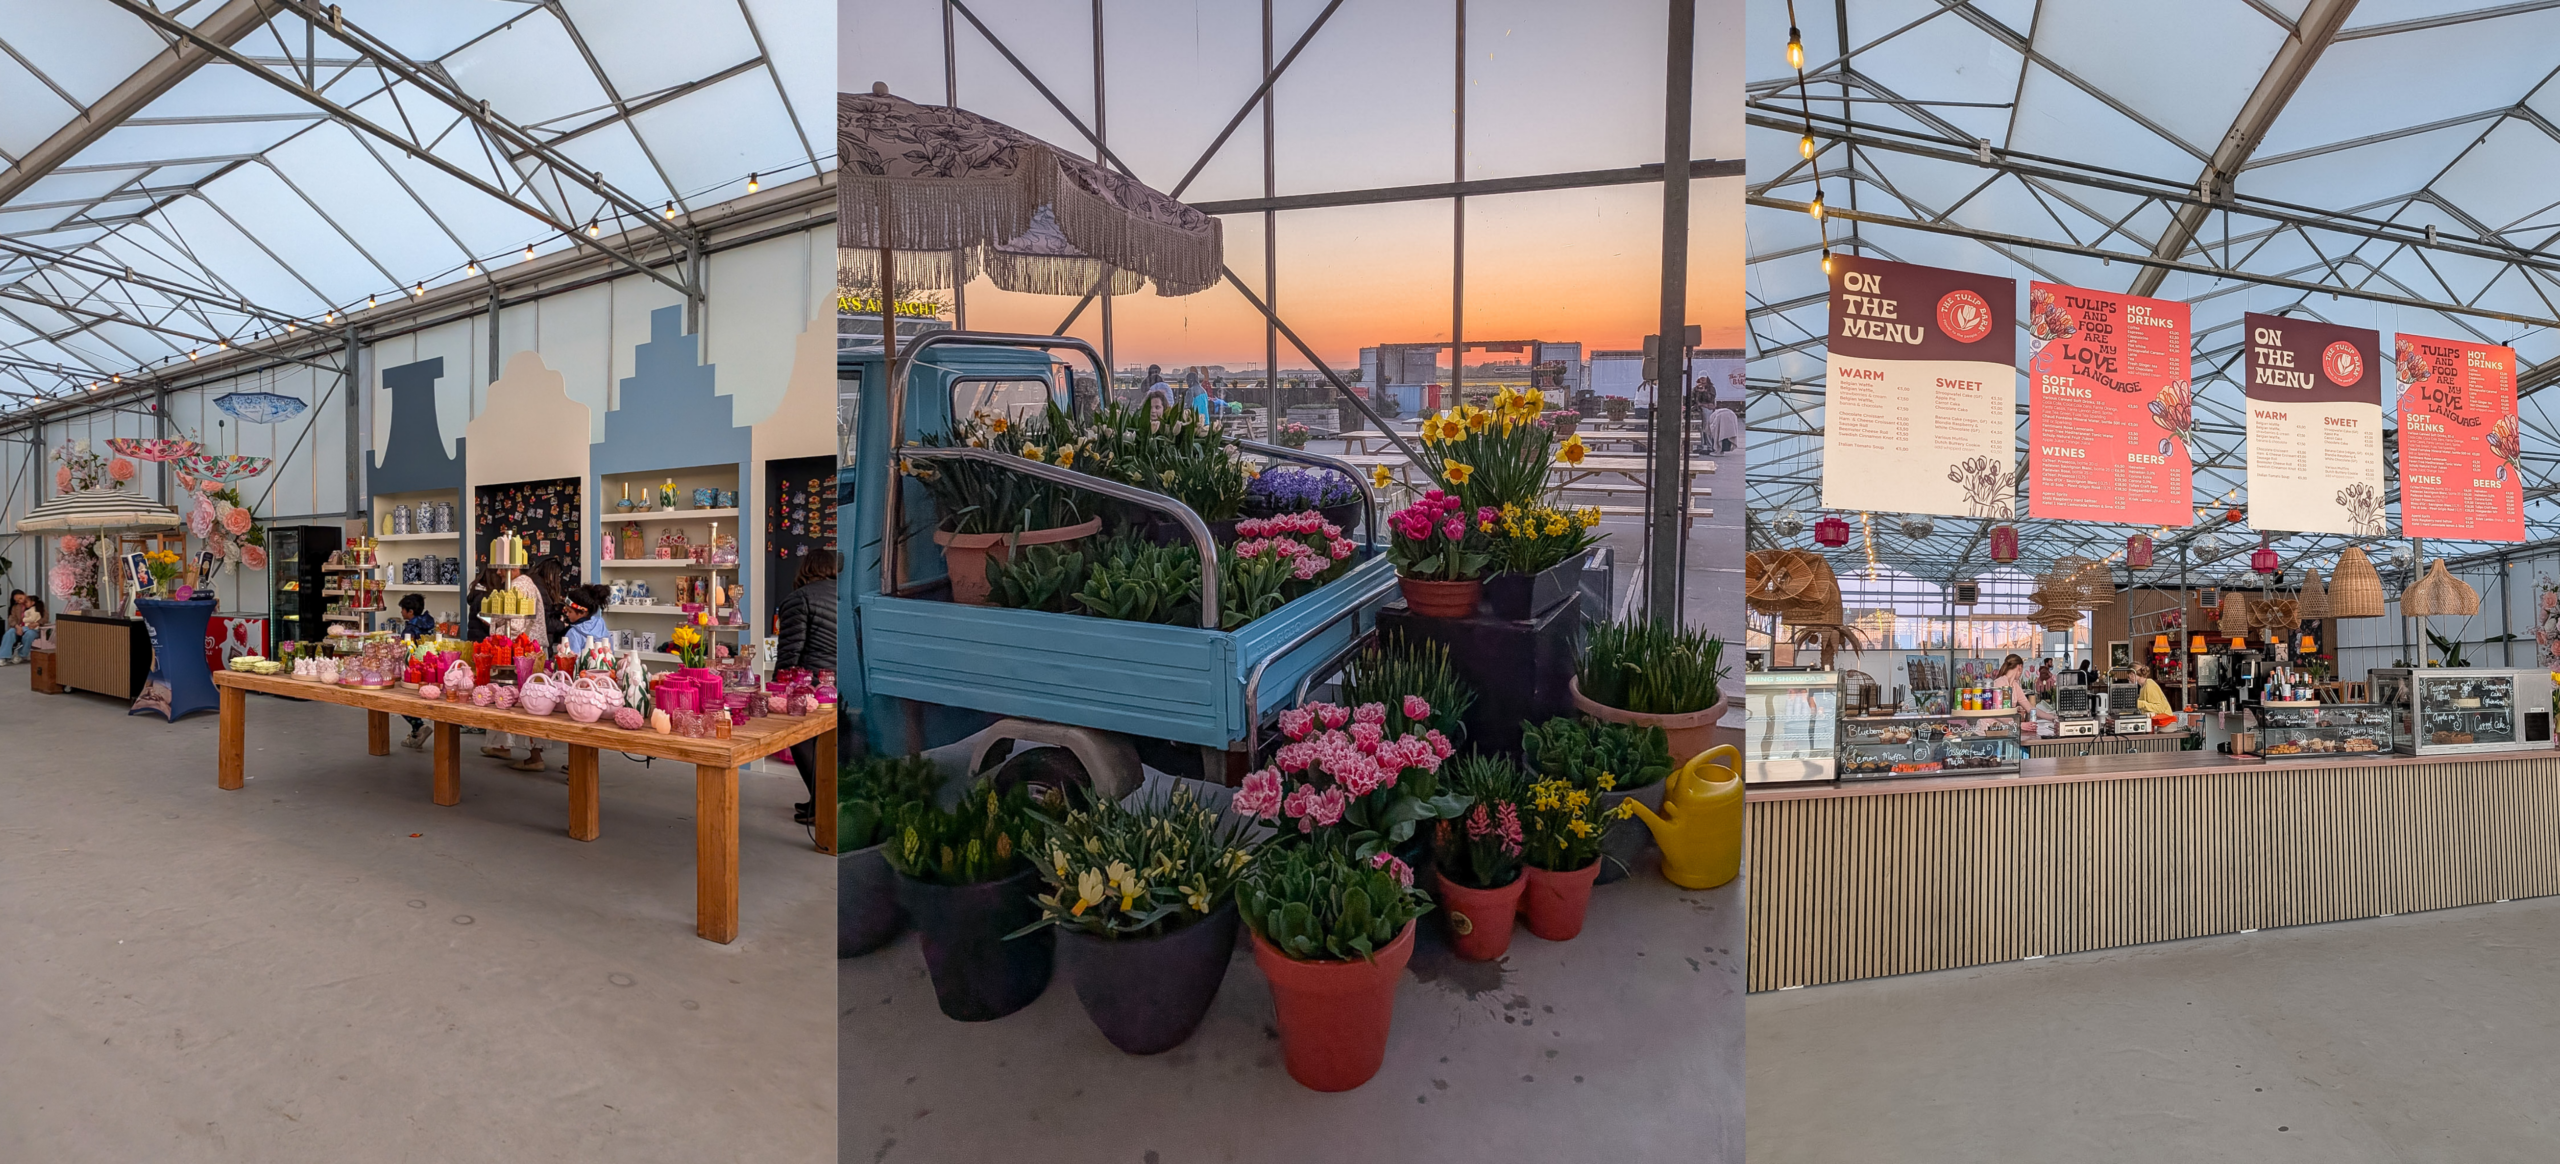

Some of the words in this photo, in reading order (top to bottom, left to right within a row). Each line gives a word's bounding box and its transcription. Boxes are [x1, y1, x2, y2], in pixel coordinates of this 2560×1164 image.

[1843, 270, 1882, 295] ON
[1842, 294, 1898, 320] THE
[2064, 295, 2117, 315] TULIPS
[2127, 304, 2152, 316] HOT
[1941, 297, 1954, 313] THE
[1955, 294, 1981, 306] TULIP
[1980, 308, 1988, 332] BARN
[2082, 310, 2108, 322] AND
[2127, 314, 2173, 328] DRINKS
[1841, 317, 1925, 345] MENU
[2078, 320, 2113, 336] FOOD
[2084, 332, 2109, 344] ARE
[2254, 327, 2283, 347] ON
[2099, 343, 2117, 355] MY
[2326, 348, 2335, 361] THE
[2335, 344, 2355, 354] TULIP
[2421, 344, 2460, 359] TULIPS
[2467, 350, 2486, 359] HOT
[2063, 343, 2118, 374] LOVE
[2254, 347, 2295, 368] THE
[2435, 357, 2454, 367] AND
[2431, 365, 2458, 377] FOOD
[2468, 359, 2503, 370] DRINKS
[1839, 367, 1884, 381] WARM
[2042, 375, 2074, 386] SOFT
[2071, 363, 2142, 394] LANGUAGE
[2254, 367, 2315, 390] MENU
[2436, 375, 2455, 385] ARE
[1936, 378, 1982, 391] SWEET
[2448, 385, 2461, 394] MY
[2042, 385, 2092, 398] DRINKS
[2420, 385, 2463, 411] LOVE
[2254, 410, 2287, 421] WARM
[2324, 416, 2358, 428] SWEET
[2406, 413, 2430, 423] SOFT
[2428, 404, 2482, 428] LANGUAGE
[2407, 422, 2444, 433] DRINKS
[2042, 445, 2086, 458] WINES
[2128, 453, 2165, 465] BEERS
[2409, 474, 2442, 485] WINES
[2473, 479, 2502, 489] BEERS
